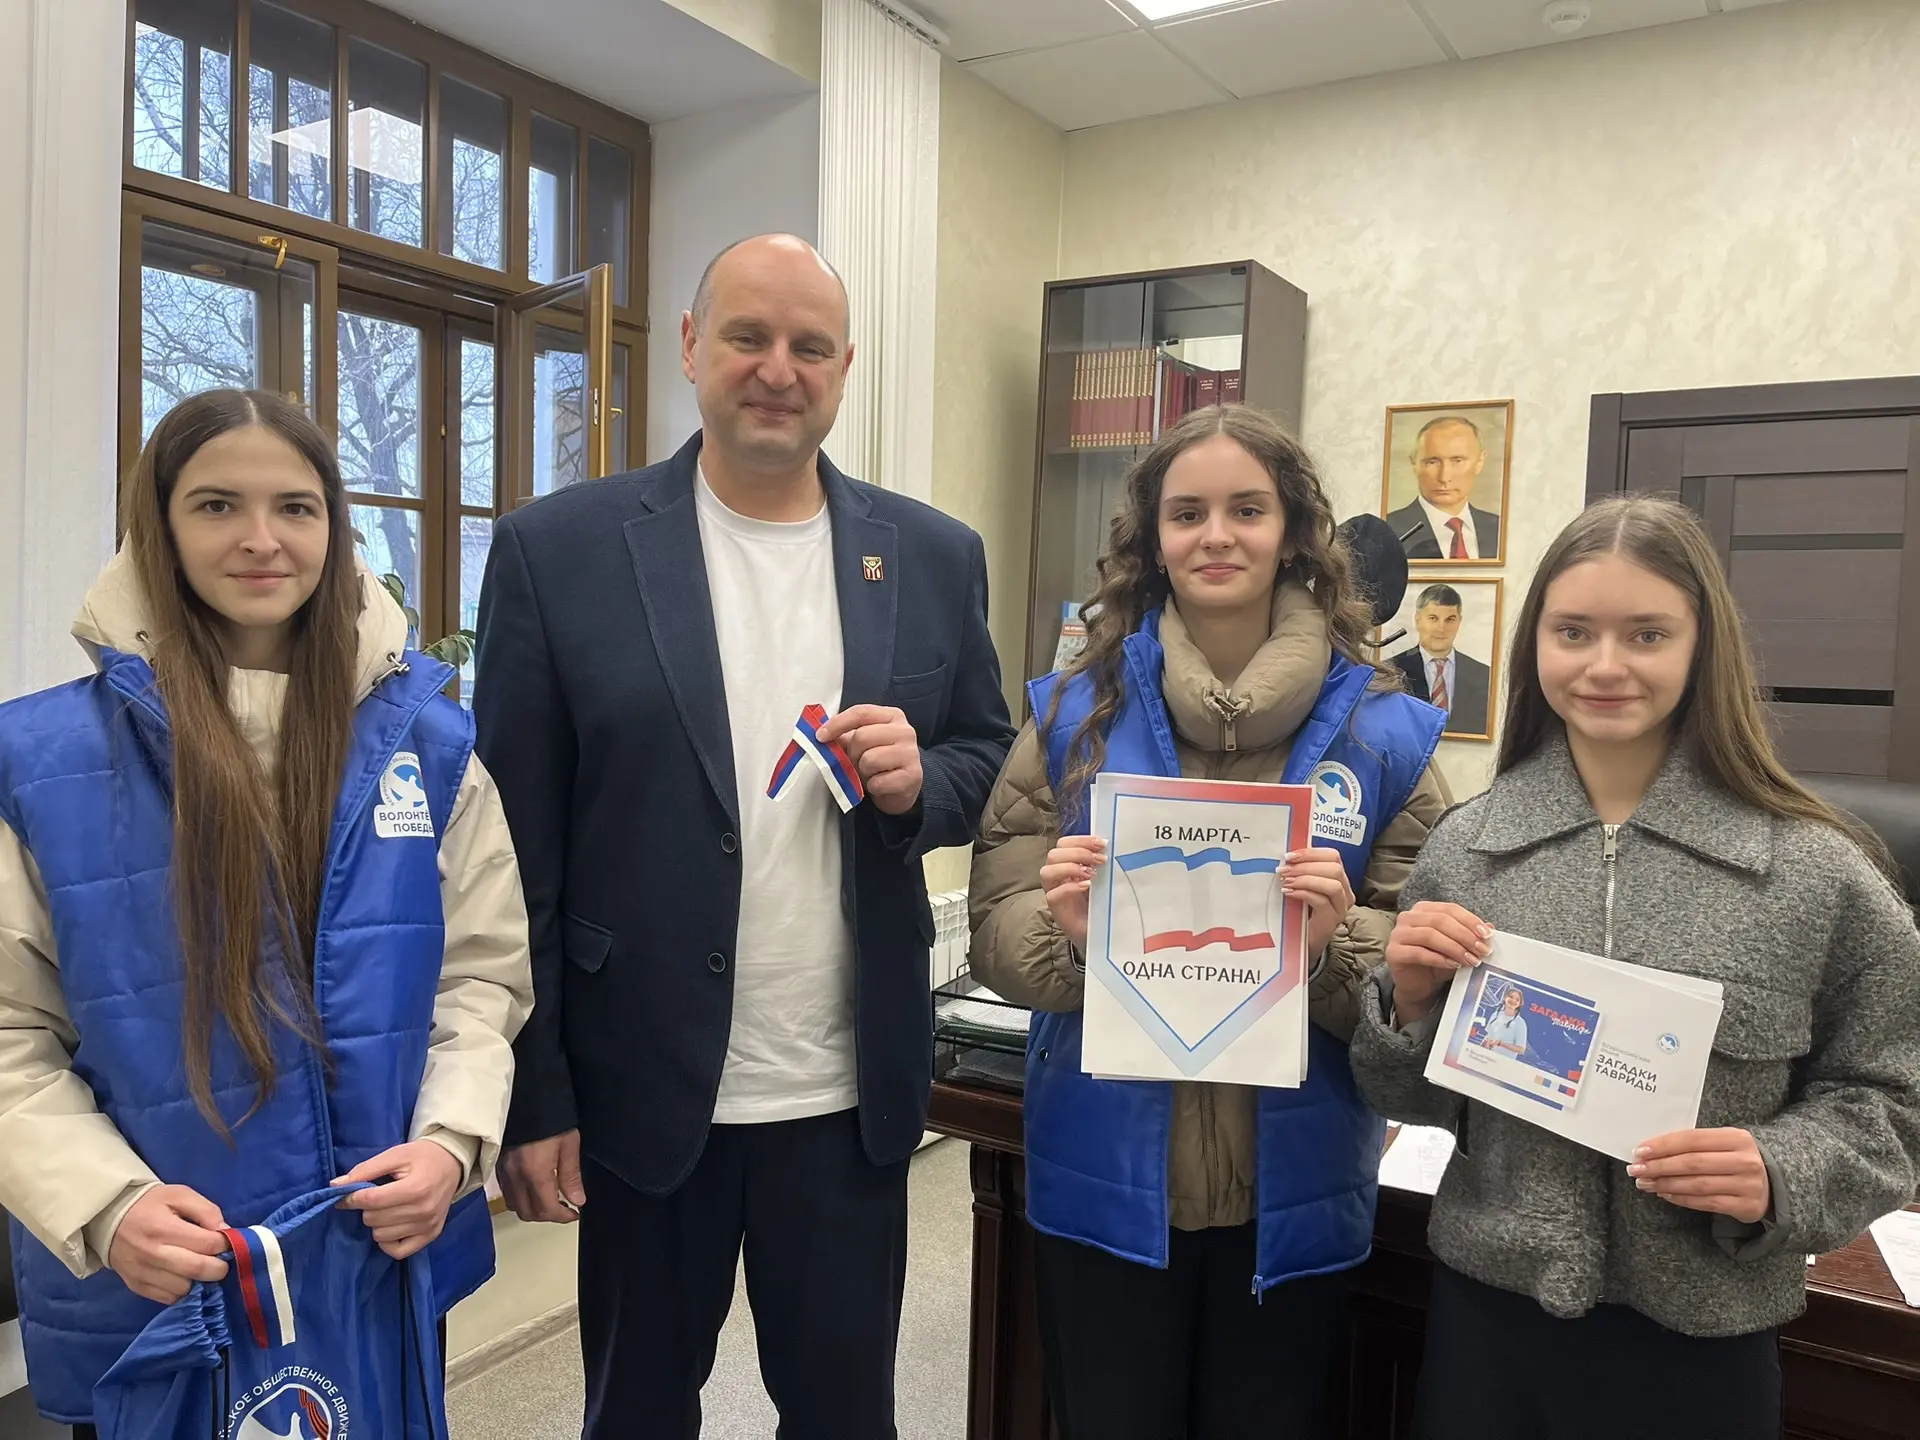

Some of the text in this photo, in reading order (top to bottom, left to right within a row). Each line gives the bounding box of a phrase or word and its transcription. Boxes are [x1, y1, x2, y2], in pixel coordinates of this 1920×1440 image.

[1154, 825, 1251, 843] 18 МАРТА-
[1315, 823, 1353, 839] ПОБЕДЫ
[1122, 961, 1262, 986] ОДНА СТРАНА!
[1594, 1063, 1658, 1094] ТАВРИДЫ
[1596, 1054, 1658, 1083] ЗАГАДКИ
[252, 1365, 339, 1397] ОБЩЕСТВЕННОЕ
